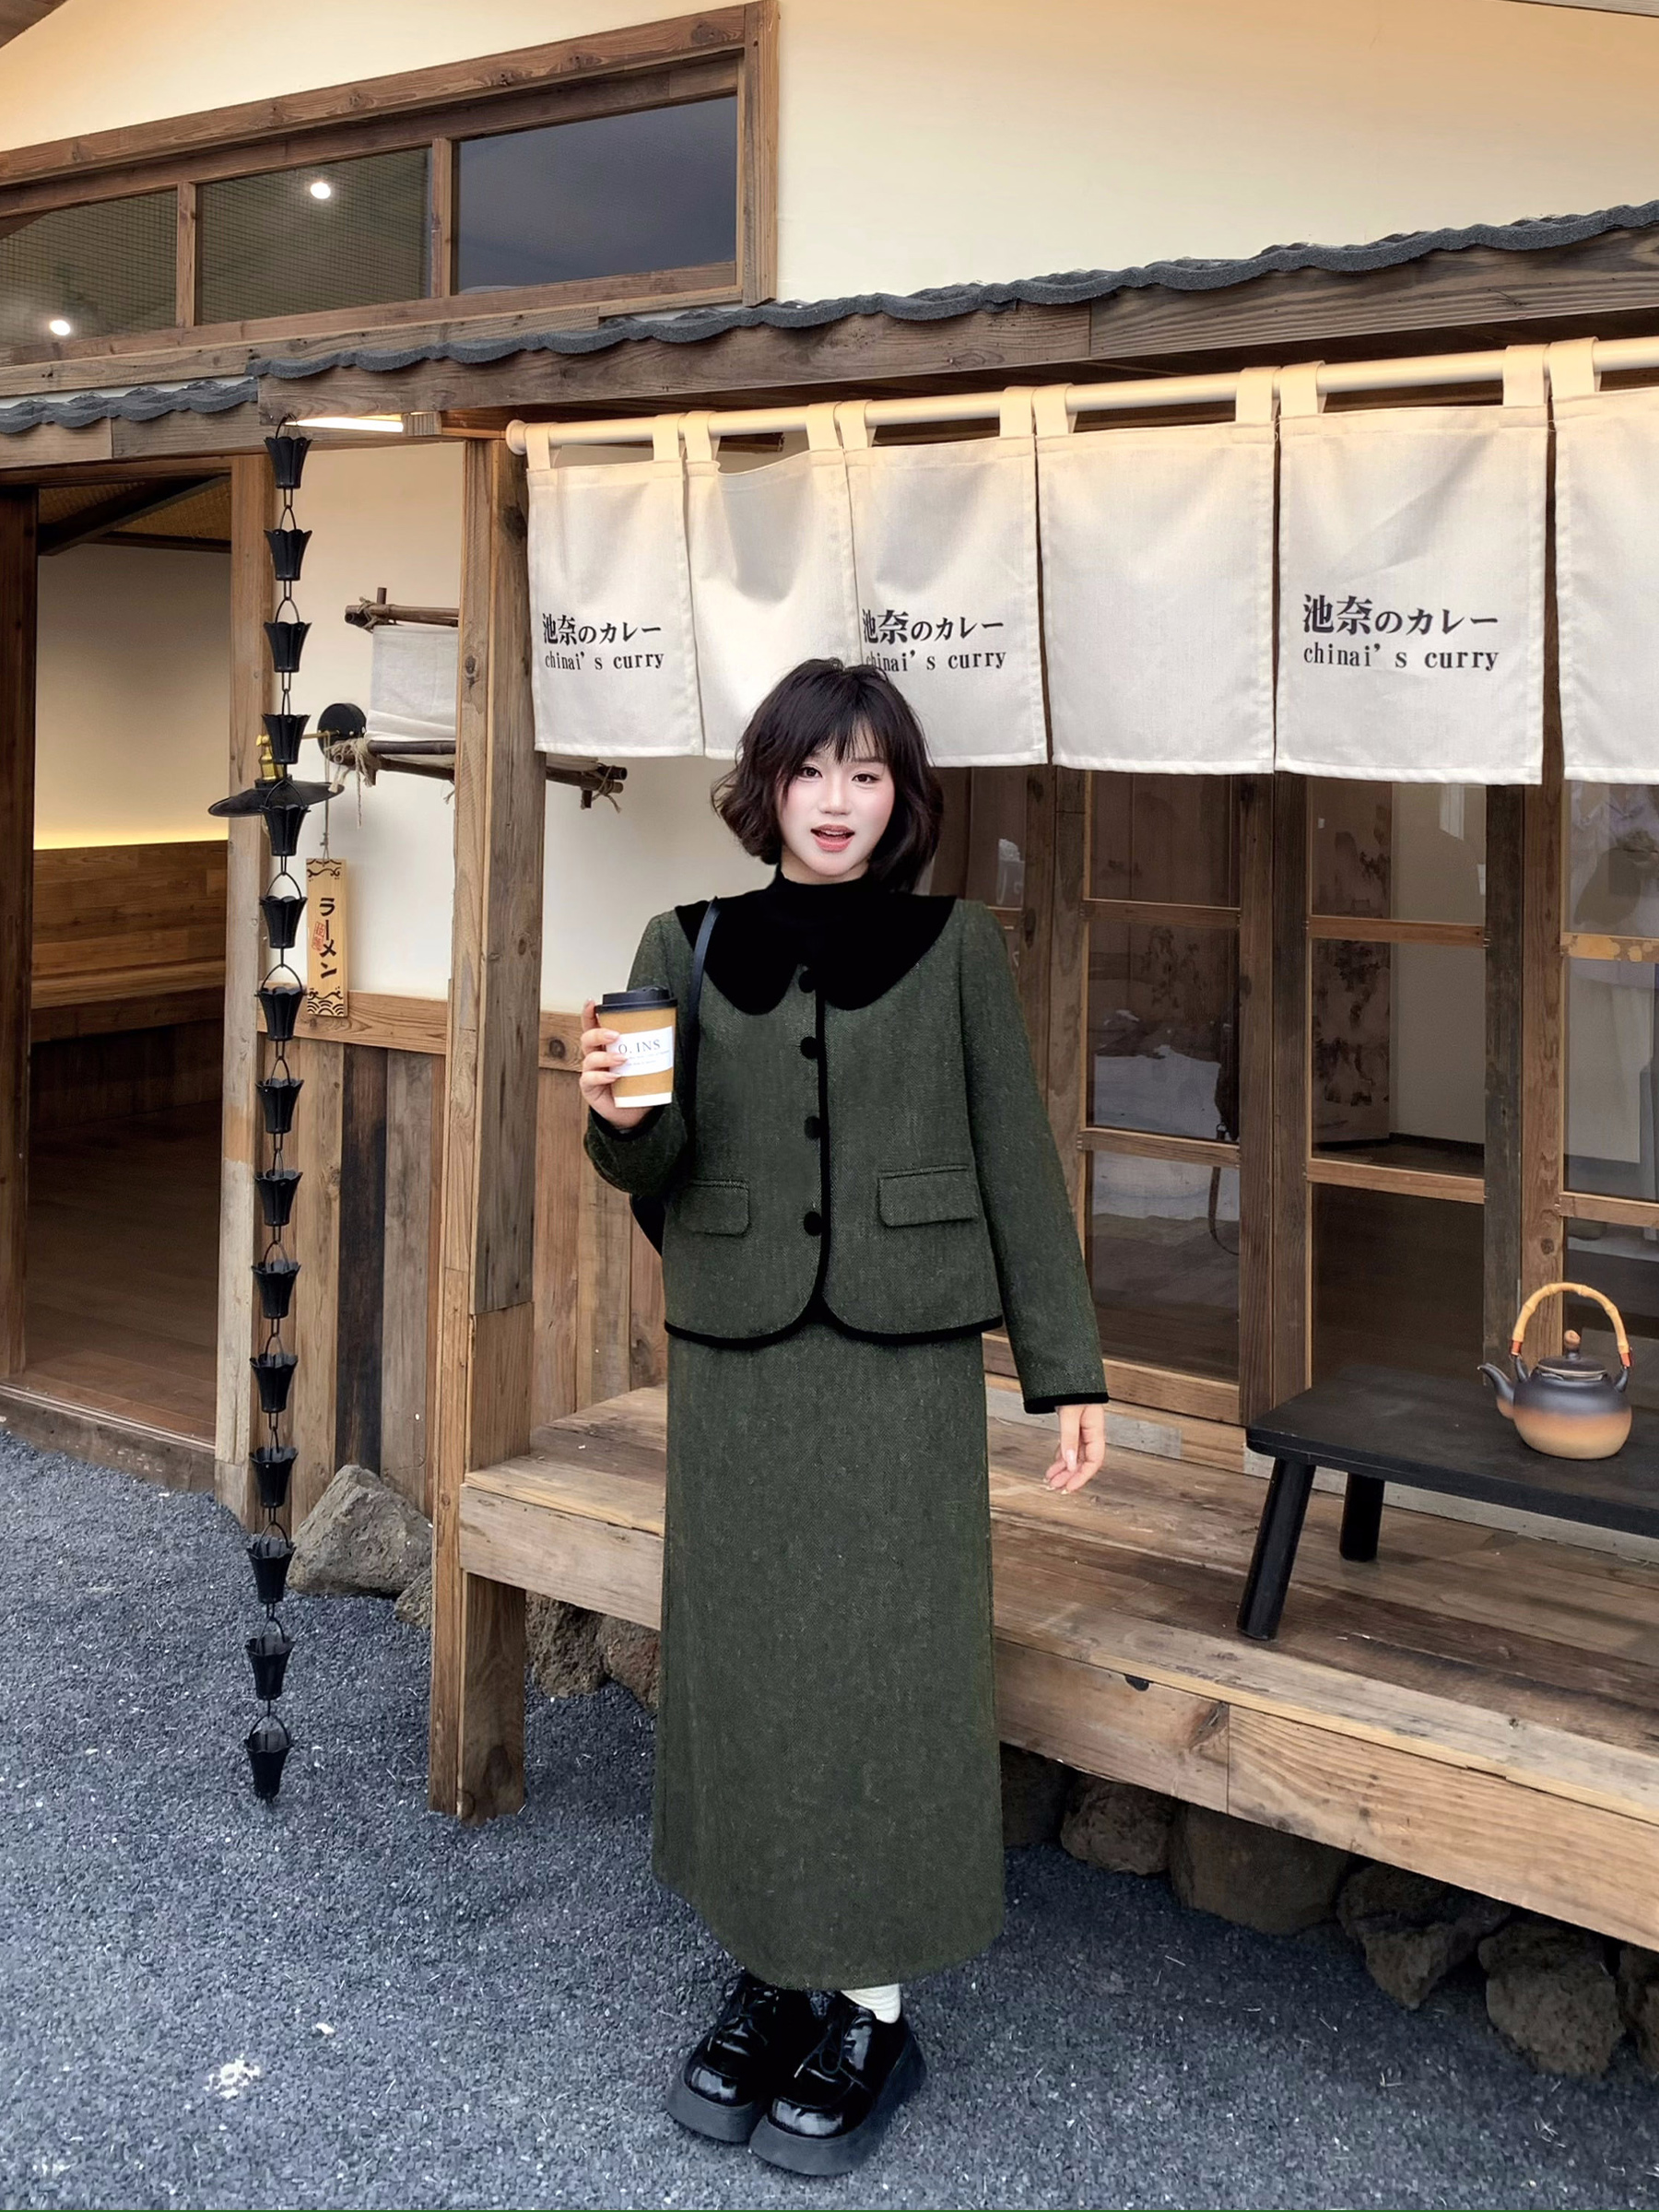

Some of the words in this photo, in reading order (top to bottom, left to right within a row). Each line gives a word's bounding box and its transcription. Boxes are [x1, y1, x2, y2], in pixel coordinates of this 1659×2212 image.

[542, 612, 662, 646] 池奈のカレー
[862, 608, 1005, 645] 池奈のカレー
[1302, 594, 1499, 636] 池奈のカレー
[613, 653, 665, 669] curry
[947, 652, 1006, 670] curry
[1424, 651, 1500, 671] curry
[319, 898, 337, 979] ラーメン
